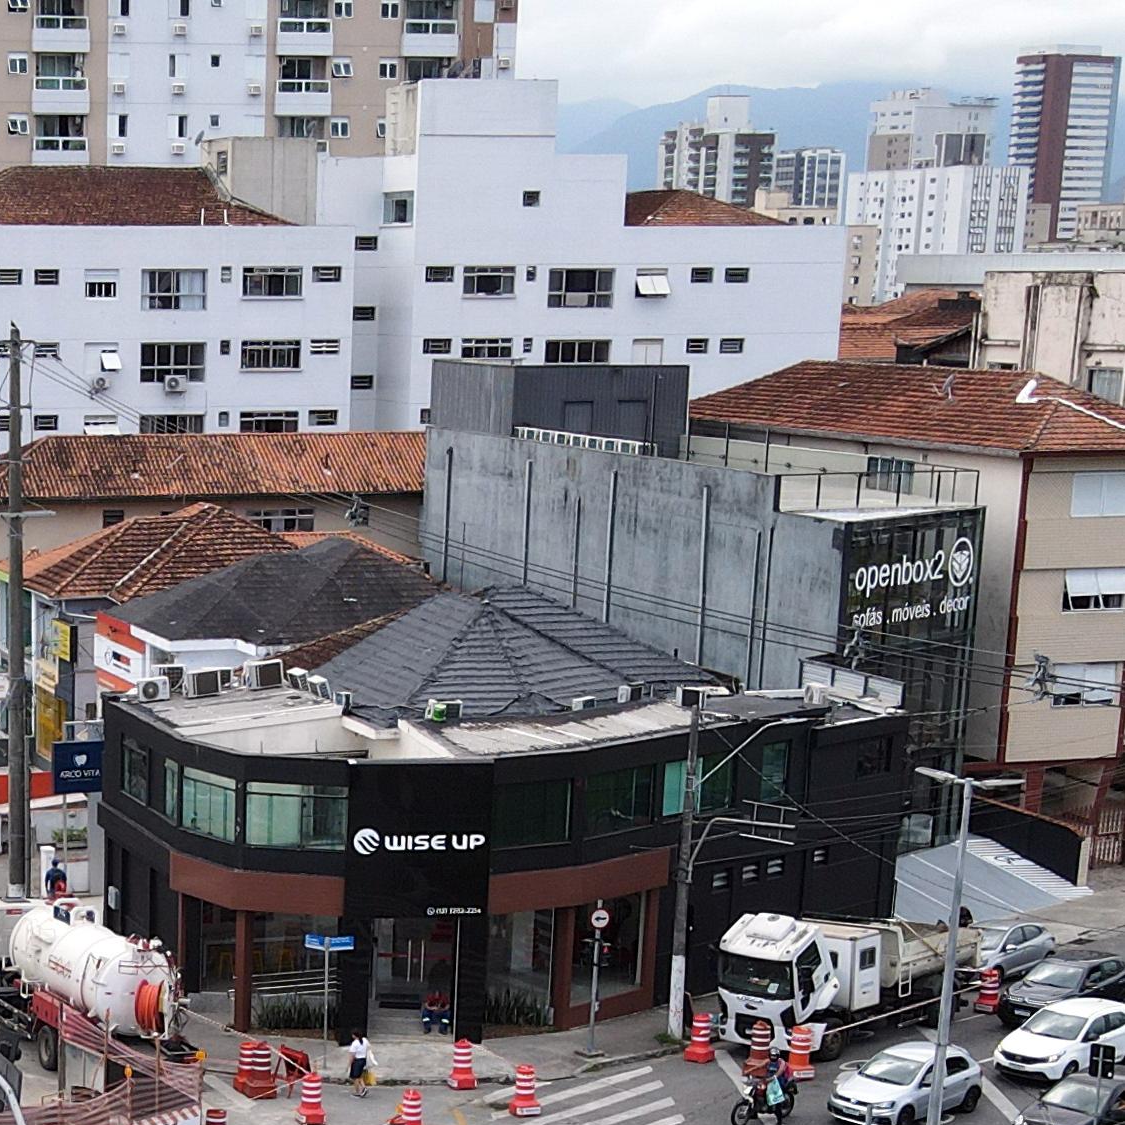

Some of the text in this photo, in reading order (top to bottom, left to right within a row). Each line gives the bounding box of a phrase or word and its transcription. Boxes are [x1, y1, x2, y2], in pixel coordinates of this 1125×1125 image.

[855, 549, 945, 598] openbox2
[853, 595, 971, 628] sofás móveis decor
[59, 770, 82, 778] ARCO
[384, 834, 486, 851] WISE UP
